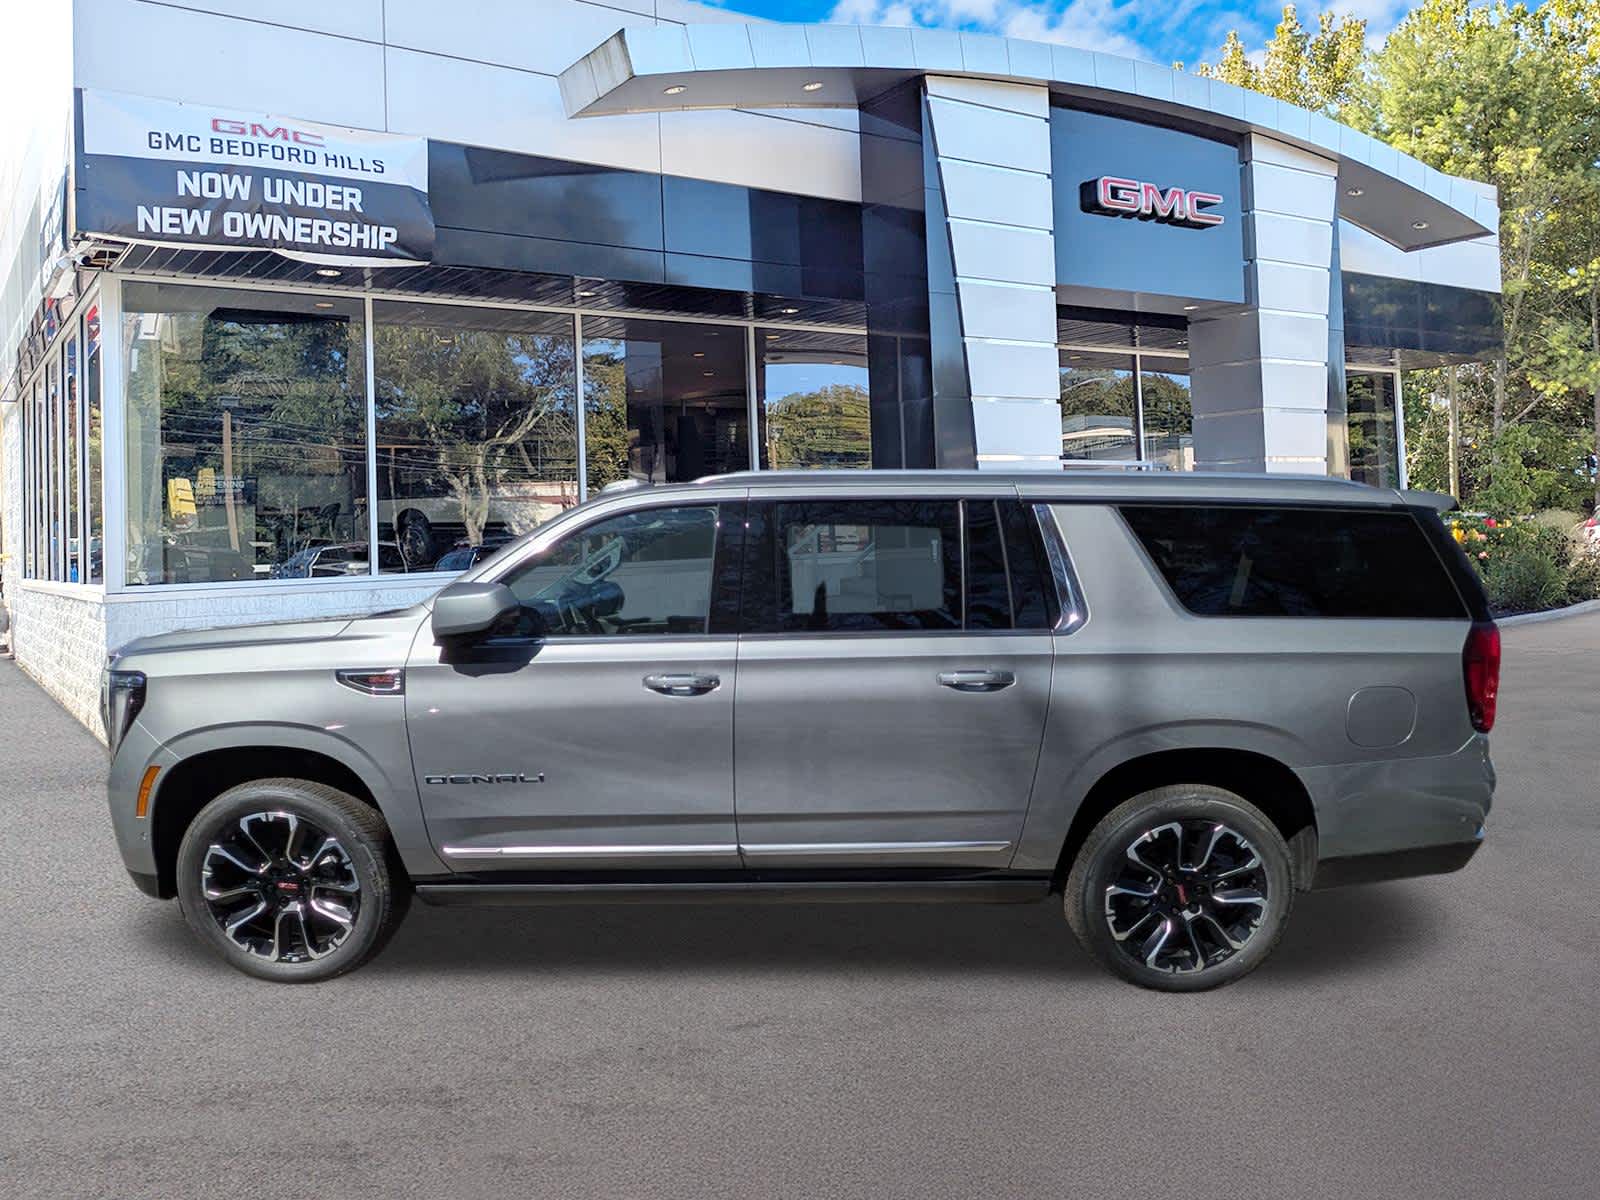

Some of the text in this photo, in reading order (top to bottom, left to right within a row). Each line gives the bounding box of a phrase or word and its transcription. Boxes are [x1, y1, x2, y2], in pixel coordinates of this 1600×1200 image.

[148, 131, 385, 174] GMC BEDFORD HILLS
[210, 117, 326, 148] GMC
[176, 170, 364, 213] NOW UNDER
[1097, 176, 1225, 224] GMC
[136, 205, 399, 250] NEW OWNERSHIP
[424, 773, 546, 785] DENALI
